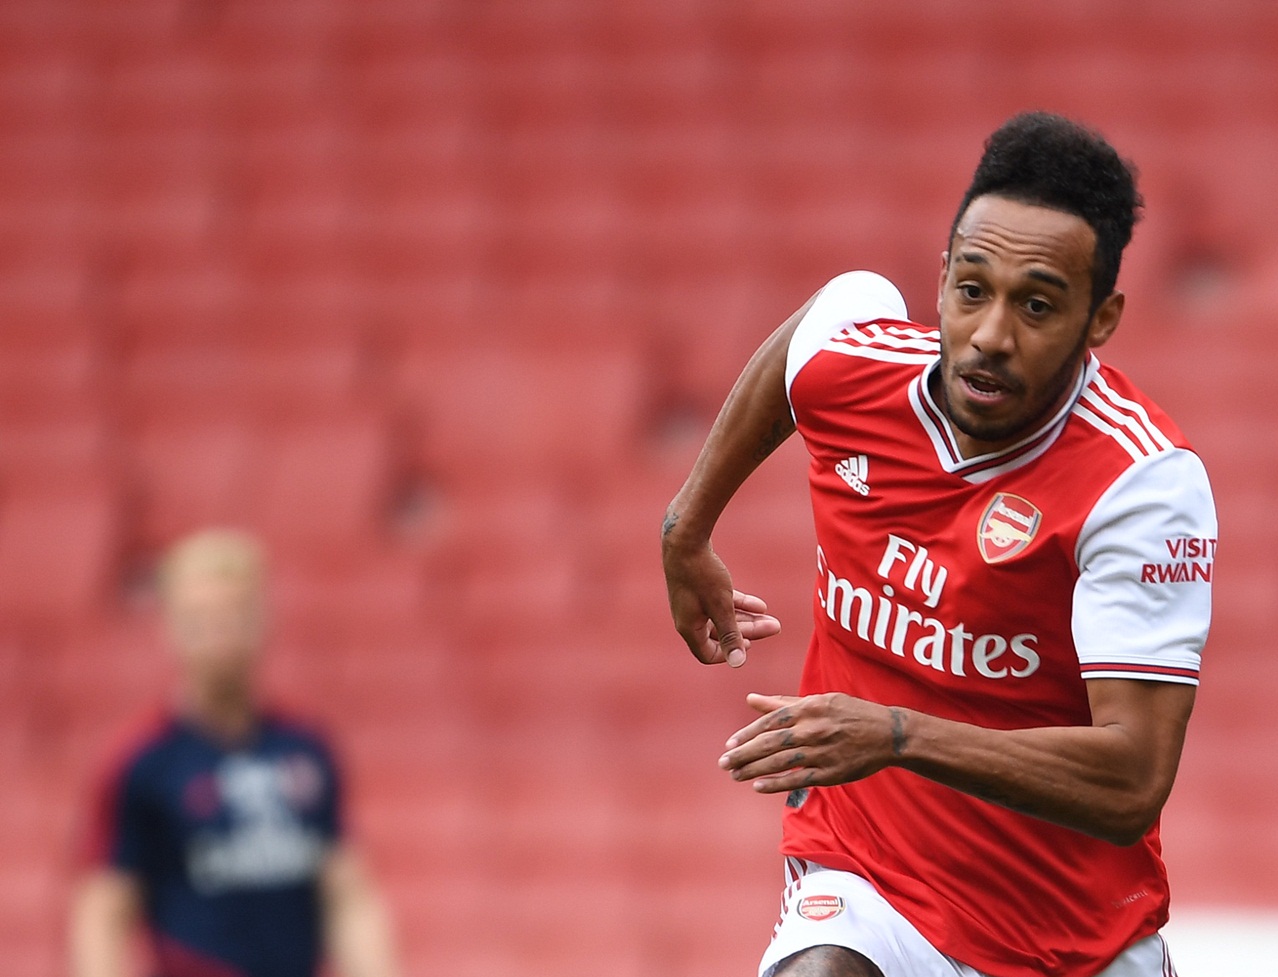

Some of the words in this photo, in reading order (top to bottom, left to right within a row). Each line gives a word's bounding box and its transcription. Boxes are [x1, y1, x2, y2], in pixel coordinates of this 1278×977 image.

[834, 463, 871, 496] adidas
[1164, 537, 1217, 559] VISIT
[877, 533, 948, 609] Fly
